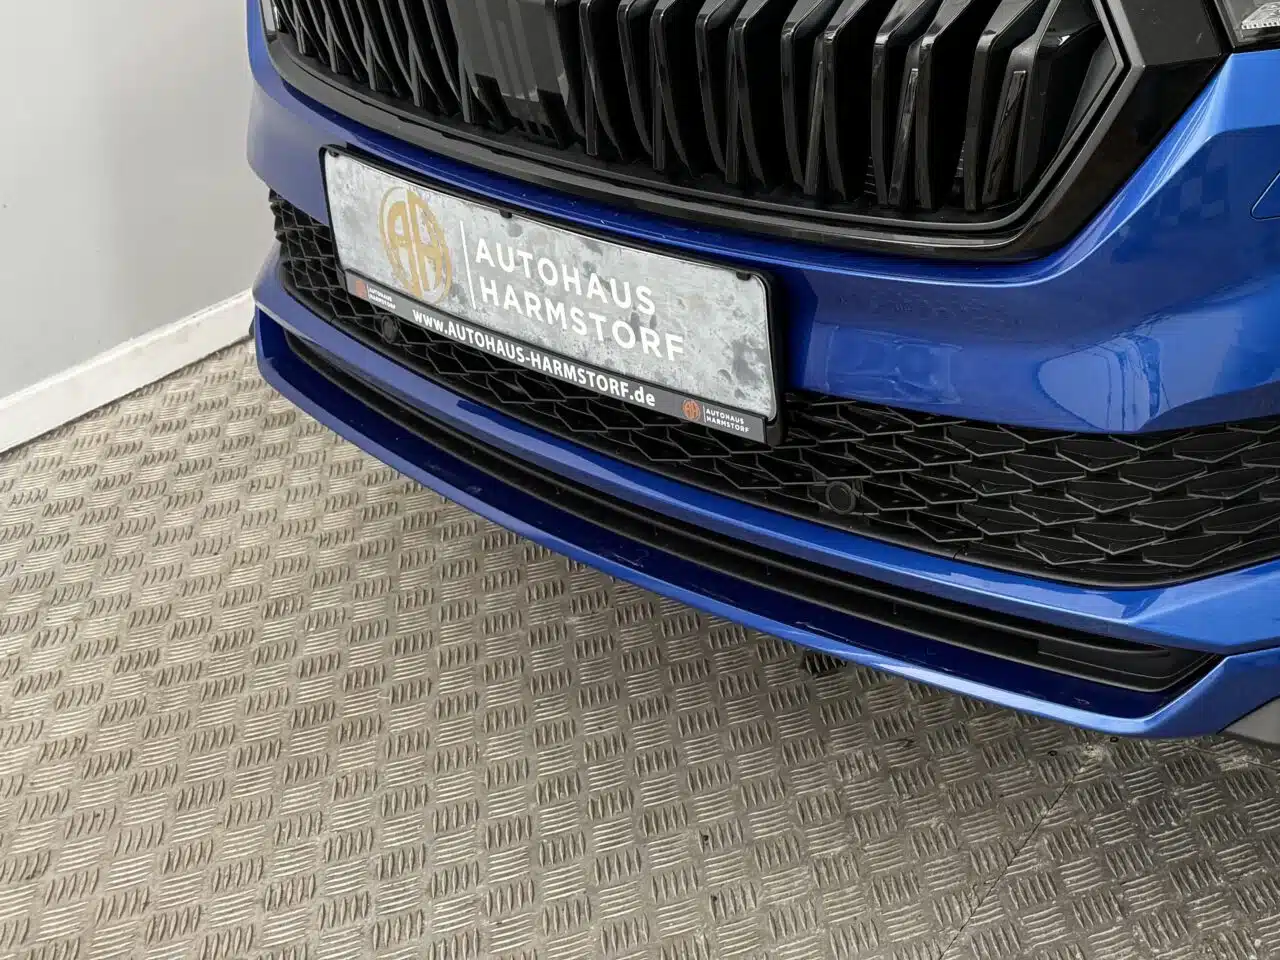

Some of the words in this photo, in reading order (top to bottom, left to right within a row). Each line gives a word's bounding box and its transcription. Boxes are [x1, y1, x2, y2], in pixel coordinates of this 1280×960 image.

[475, 238, 656, 315] AUTOHAUS
[479, 276, 684, 361] HARMSTORF
[412, 309, 656, 407] www.AUTOHAUS-HARMSTORF.de
[705, 408, 745, 425] AUTOHAUS
[705, 415, 750, 433] HARMSTORF
